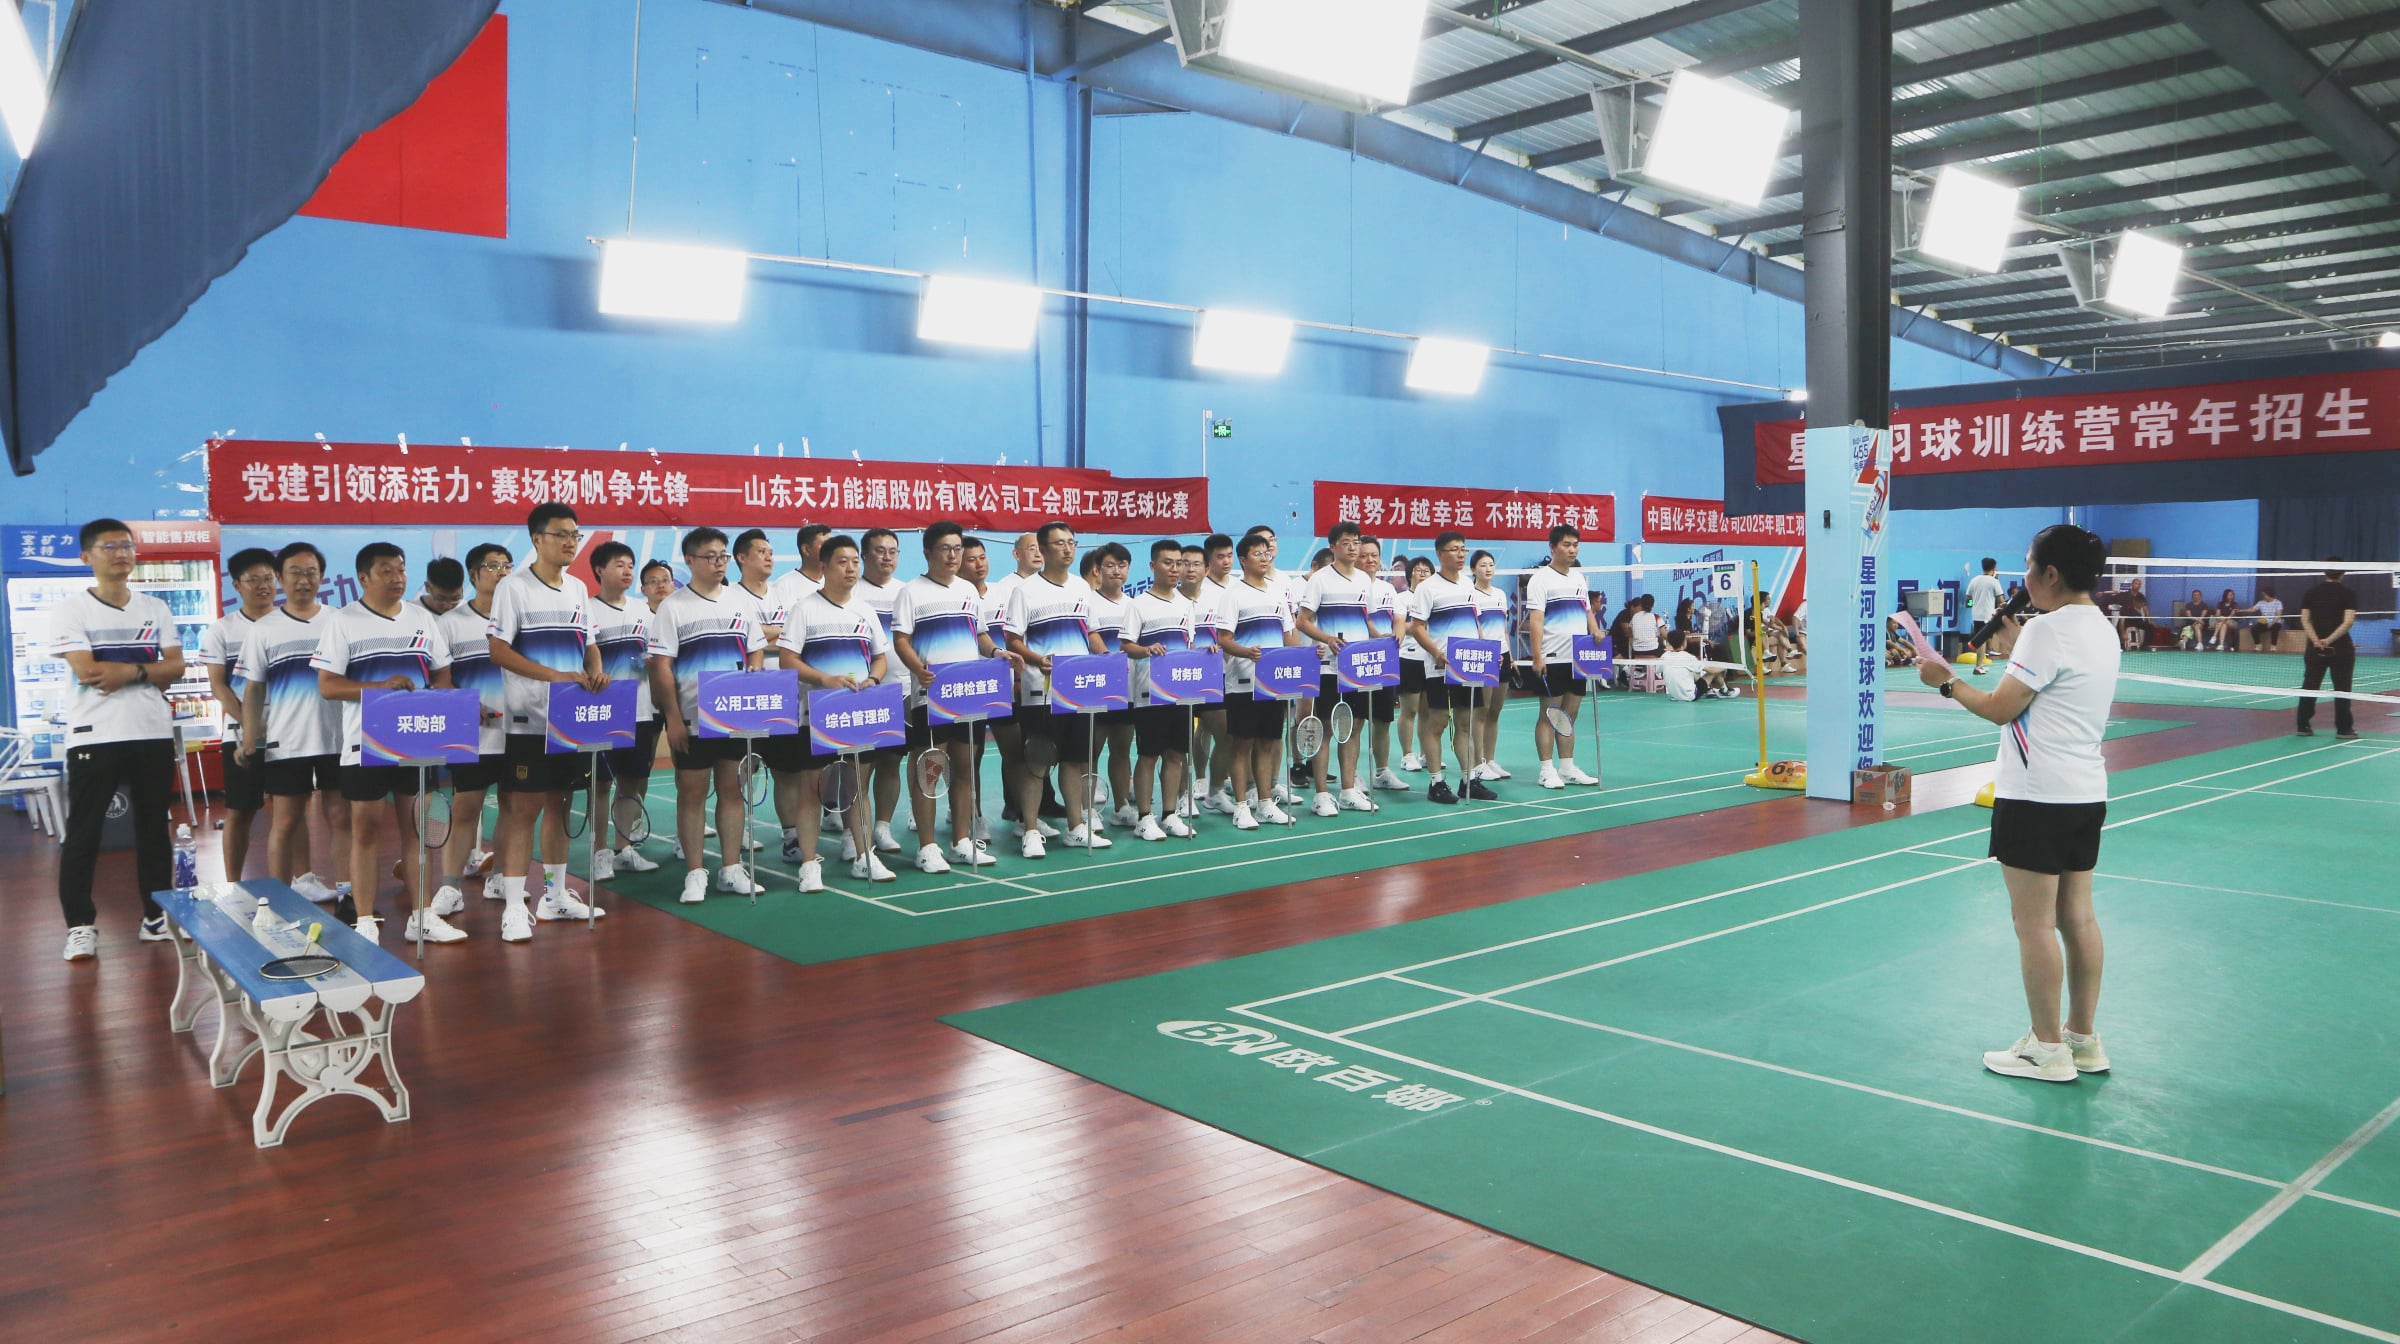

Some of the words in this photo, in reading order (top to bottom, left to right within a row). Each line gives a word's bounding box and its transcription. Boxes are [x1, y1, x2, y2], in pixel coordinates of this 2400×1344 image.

[1338, 494, 1474, 527] 越努力越幸运
[1486, 499, 1599, 532] 不拼搏无奇迹
[21, 534, 74, 546] 宝矿力
[142, 530, 211, 544] 智能售货柜
[21, 546, 55, 557] 水特
[1720, 573, 1732, 591] 6
[1351, 650, 1386, 666] 国际工程
[1455, 648, 1493, 662] 新能源科技
[1074, 673, 1107, 689] 生产部
[1171, 667, 1203, 682] 财务部
[1274, 666, 1302, 680] 仪电室
[940, 678, 999, 699] 纪律检查室
[714, 694, 783, 712] 公用工程室
[574, 704, 612, 723] 设备部
[825, 707, 891, 729] 综合管理部
[396, 714, 447, 734] 采购部
